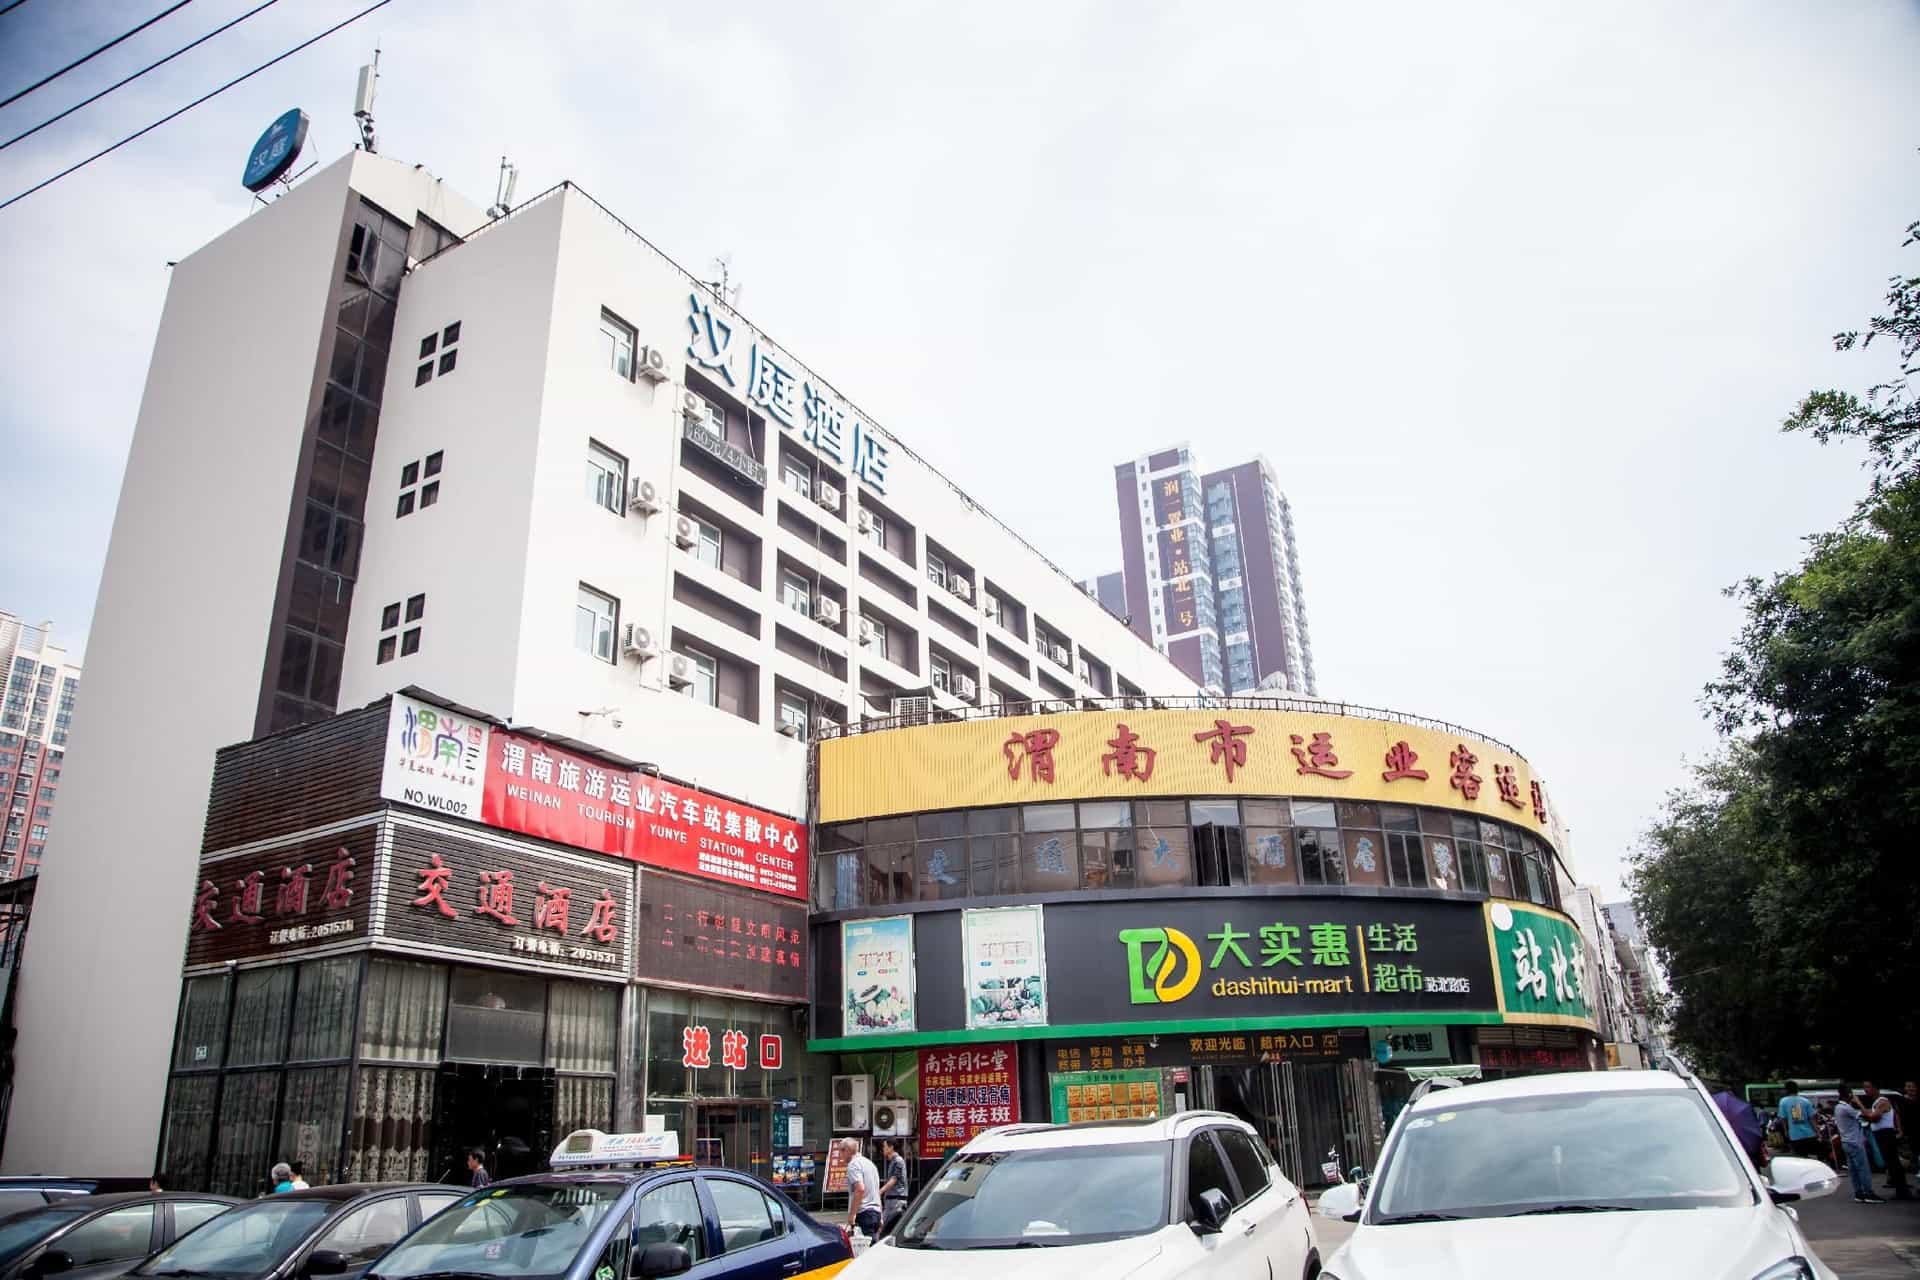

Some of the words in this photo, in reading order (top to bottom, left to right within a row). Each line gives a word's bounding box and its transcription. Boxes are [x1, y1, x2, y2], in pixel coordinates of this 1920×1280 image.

[687, 293, 889, 496] 汉庭酒店
[1003, 718, 1547, 825] 渭南市运业客运站
[403, 787, 468, 815] NO.WL002
[501, 741, 800, 854] 渭南旅游运业汽车站集散中心
[506, 783, 561, 810] WEINAN
[576, 802, 635, 831] TOURISM
[649, 822, 688, 845] YUNYE
[699, 837, 745, 858] STATION
[754, 851, 795, 872] CENTER
[410, 852, 617, 942] 交通酒店
[1207, 922, 1351, 968] 大实惠
[1368, 923, 1418, 952] 生活
[1211, 976, 1354, 998] dashihui-mart
[1373, 963, 1423, 993] 超市
[683, 1025, 782, 1069] 进站口
[925, 1047, 1009, 1073] 南京同仁堂
[1190, 1036, 1246, 1051] 欢迎光临
[1260, 1035, 1314, 1050] 超市入口
